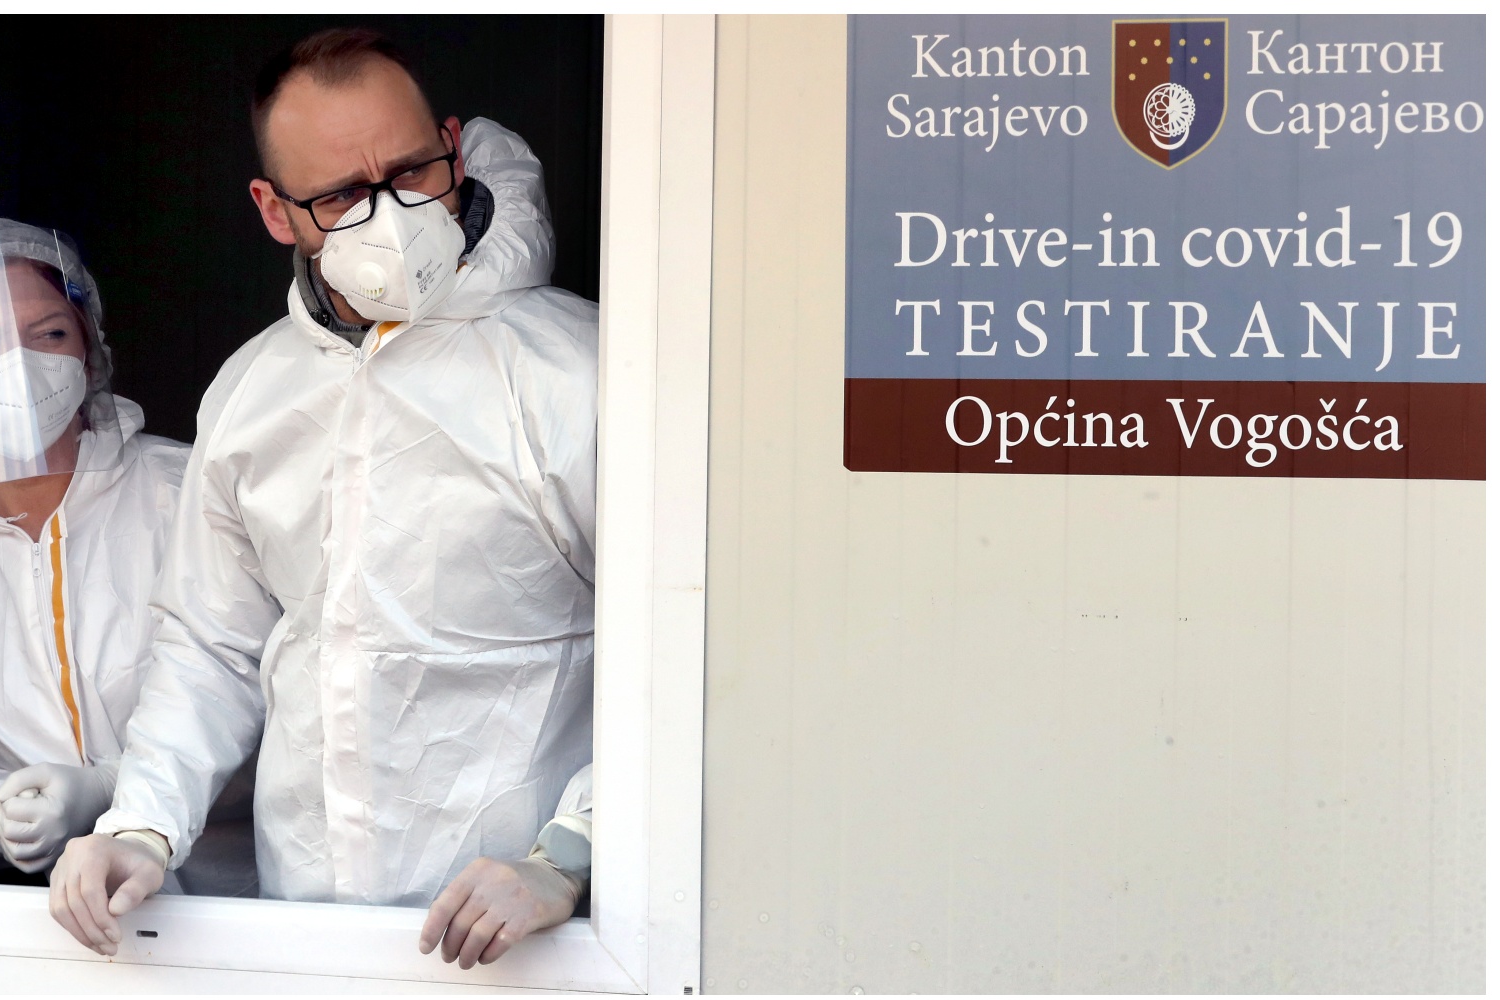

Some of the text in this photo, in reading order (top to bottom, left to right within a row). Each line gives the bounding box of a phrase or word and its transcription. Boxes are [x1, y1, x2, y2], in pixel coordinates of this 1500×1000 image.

[911, 34, 1091, 78] Kanton
[1246, 29, 1444, 75] Кантон
[886, 93, 1089, 153] Sarajevo
[1245, 88, 1485, 150] Сарајево
[893, 205, 1464, 269] Drive-in covid-19
[894, 298, 1462, 373] TESTIRANJE
[945, 395, 1404, 468] Općina Vogošća
